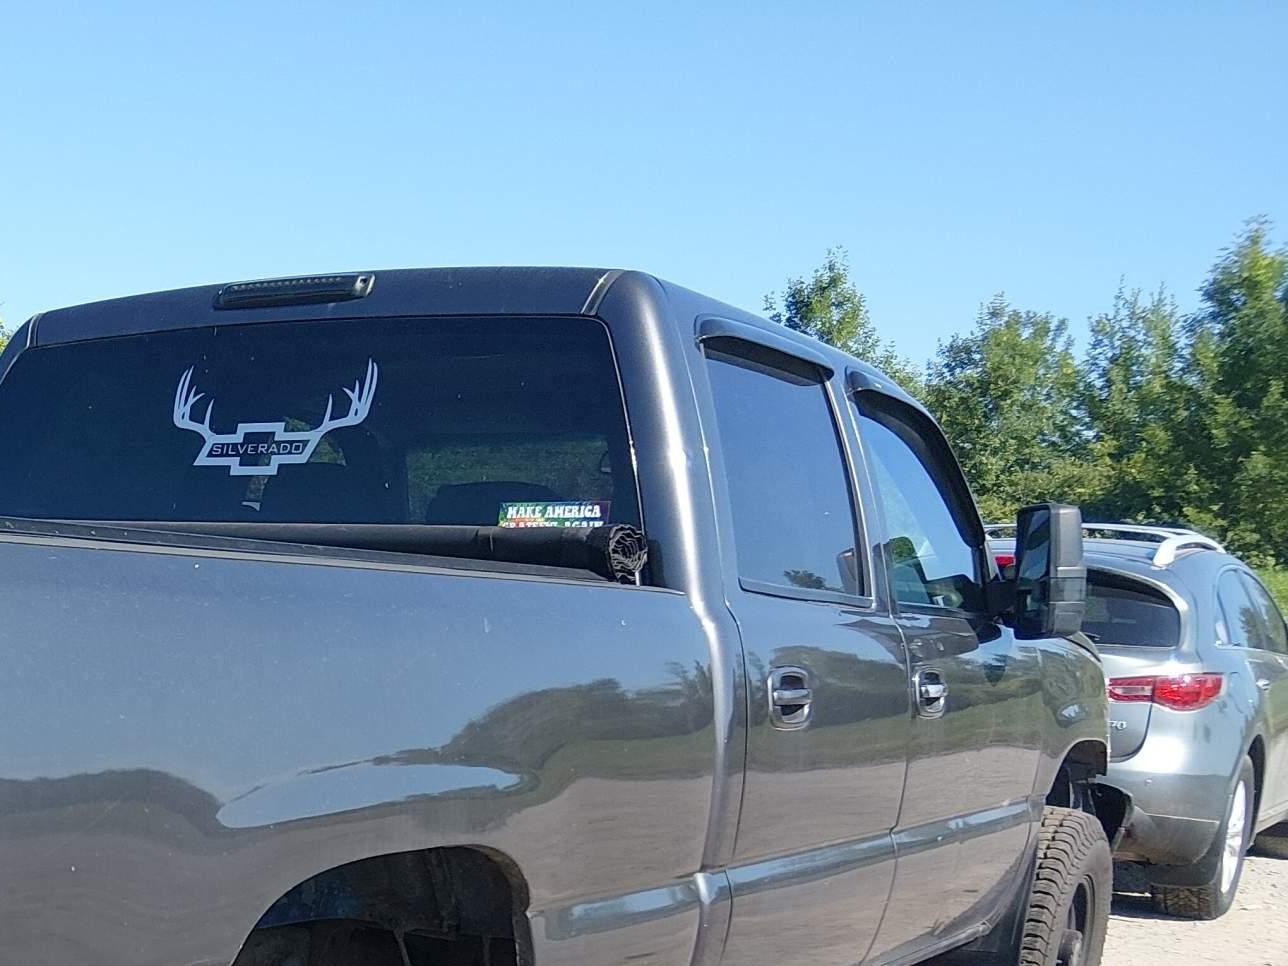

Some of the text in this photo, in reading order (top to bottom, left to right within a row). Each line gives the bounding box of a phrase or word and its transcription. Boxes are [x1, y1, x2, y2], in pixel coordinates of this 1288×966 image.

[212, 442, 303, 455] SILVERADO
[506, 504, 601, 518] MAKE AMERICA
